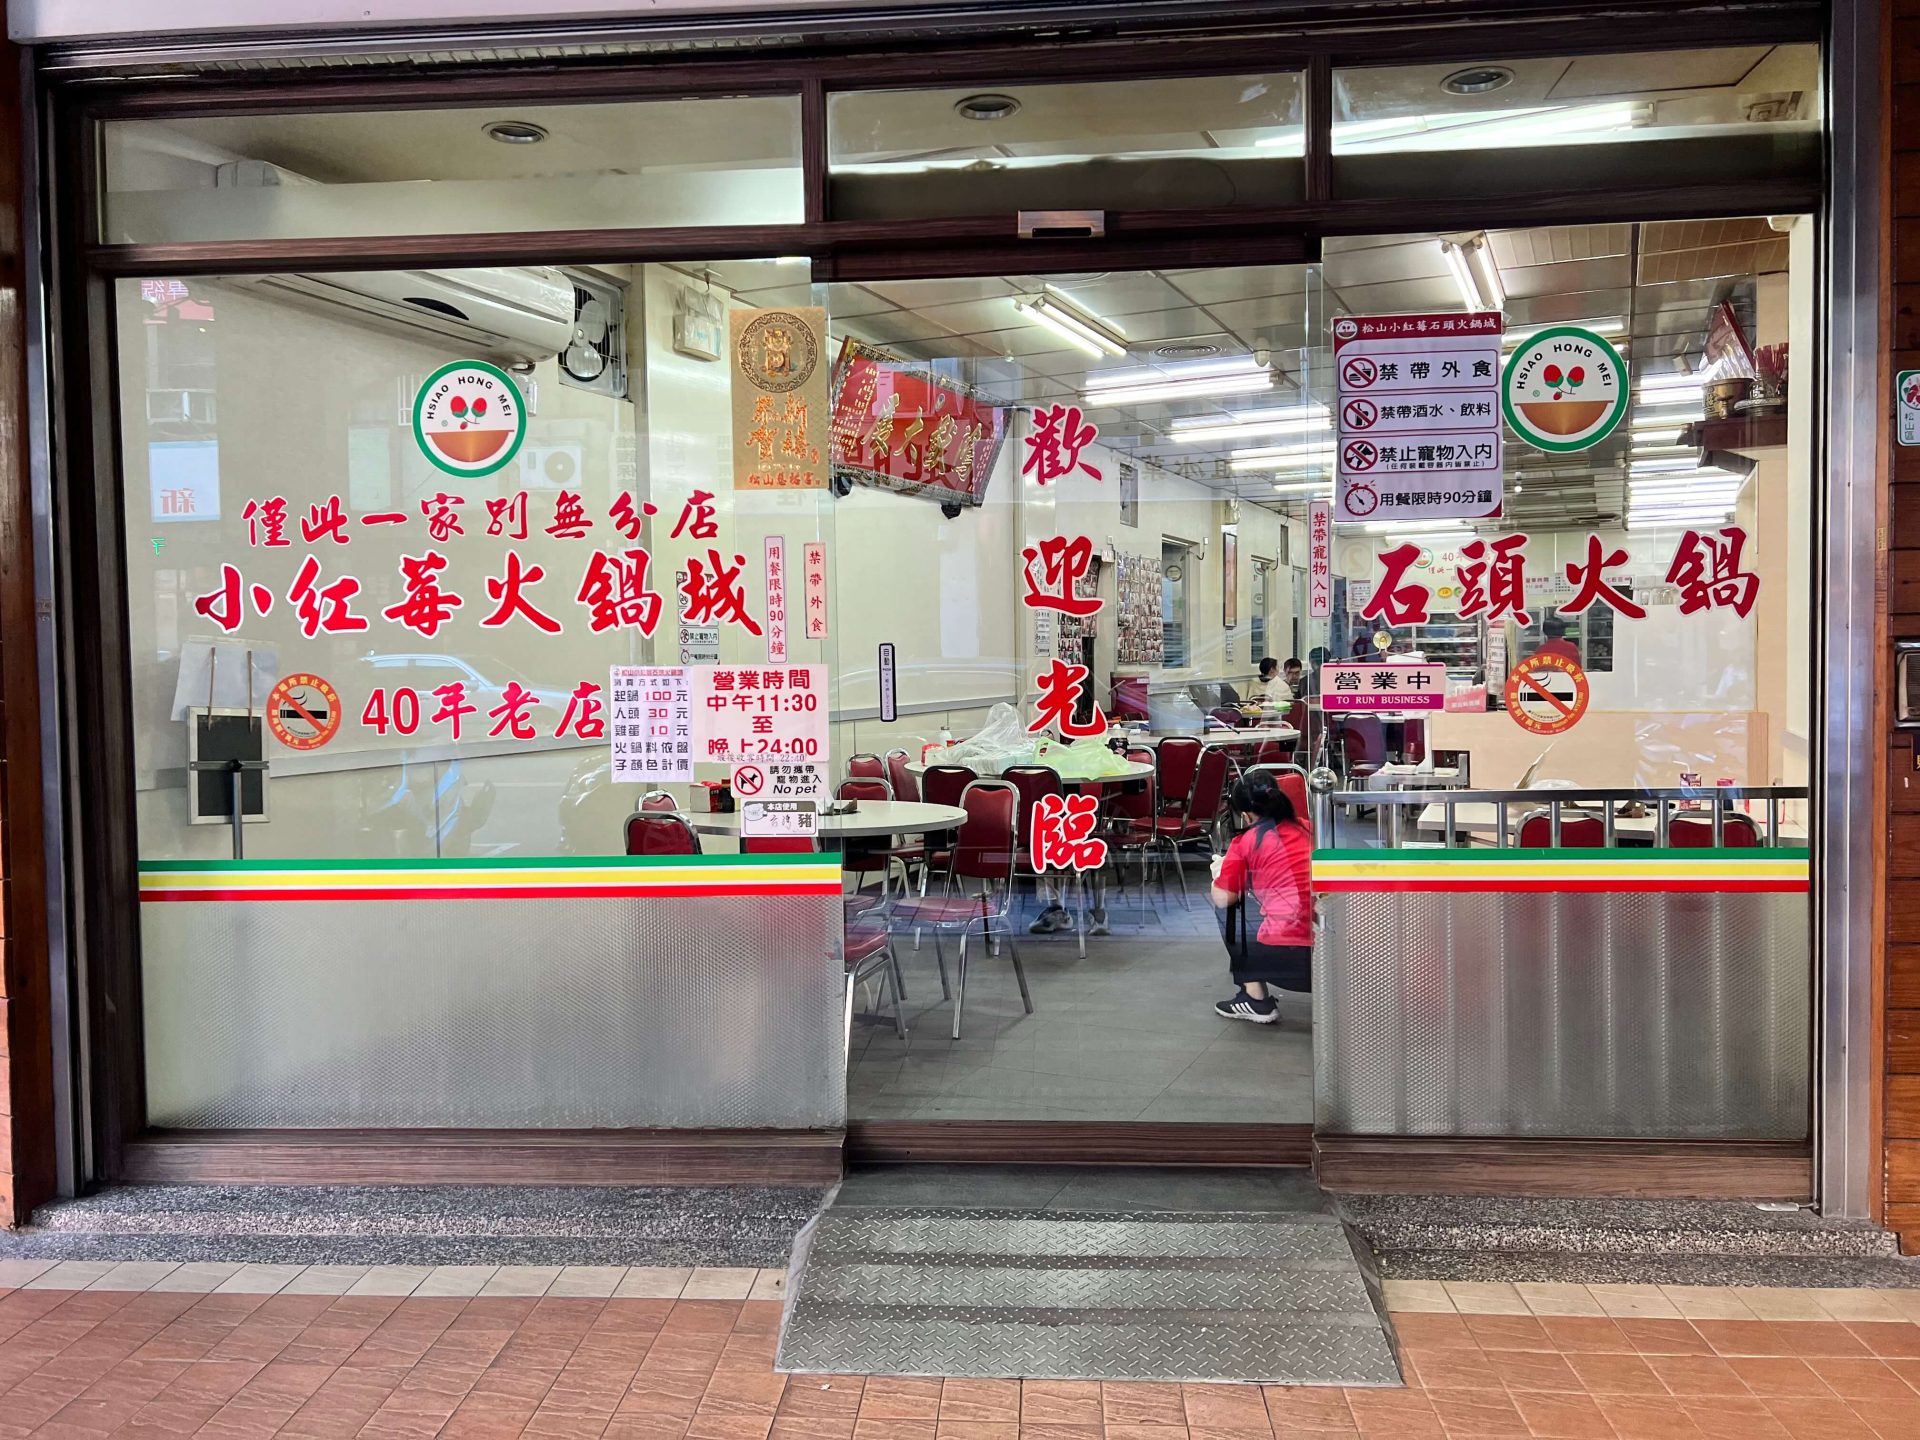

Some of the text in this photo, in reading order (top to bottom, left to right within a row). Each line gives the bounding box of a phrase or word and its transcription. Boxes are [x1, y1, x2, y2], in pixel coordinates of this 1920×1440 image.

[1362, 318, 1497, 334] 松山小紅莓石頭火鍋城
[1378, 360, 1492, 381] 禁帶外食
[1516, 343, 1612, 390] HSIAO HONG MEI
[427, 375, 512, 420] HSIAO HONG MEI
[1380, 401, 1491, 419] 禁帶酒水、飲料
[1379, 489, 1493, 507] 用餐限時90分鐘
[1362, 527, 1761, 629] 石頭火鍋
[809, 550, 824, 632] 禁帶外食
[768, 546, 785, 655] 用餐限時90分鐘
[1022, 403, 1109, 874] 歡迎光臨
[712, 669, 810, 691] 營業時間
[1334, 671, 1431, 690] 營業中
[614, 690, 688, 702] 起鍋 100 元
[707, 694, 818, 712] 中午11:30
[1336, 695, 1430, 704] TO RUN BUSINESS
[361, 681, 605, 741] 40年老店
[614, 707, 688, 719] 人頭 30 元
[614, 725, 688, 737] 雞蛋 10 元
[752, 716, 773, 734] 至
[615, 742, 689, 754] 火鍋料依盤
[769, 765, 815, 775] 請勿攜帶
[776, 775, 822, 784] 寵物進入
[773, 785, 817, 796] No pet
[767, 803, 798, 811] 本店使用
